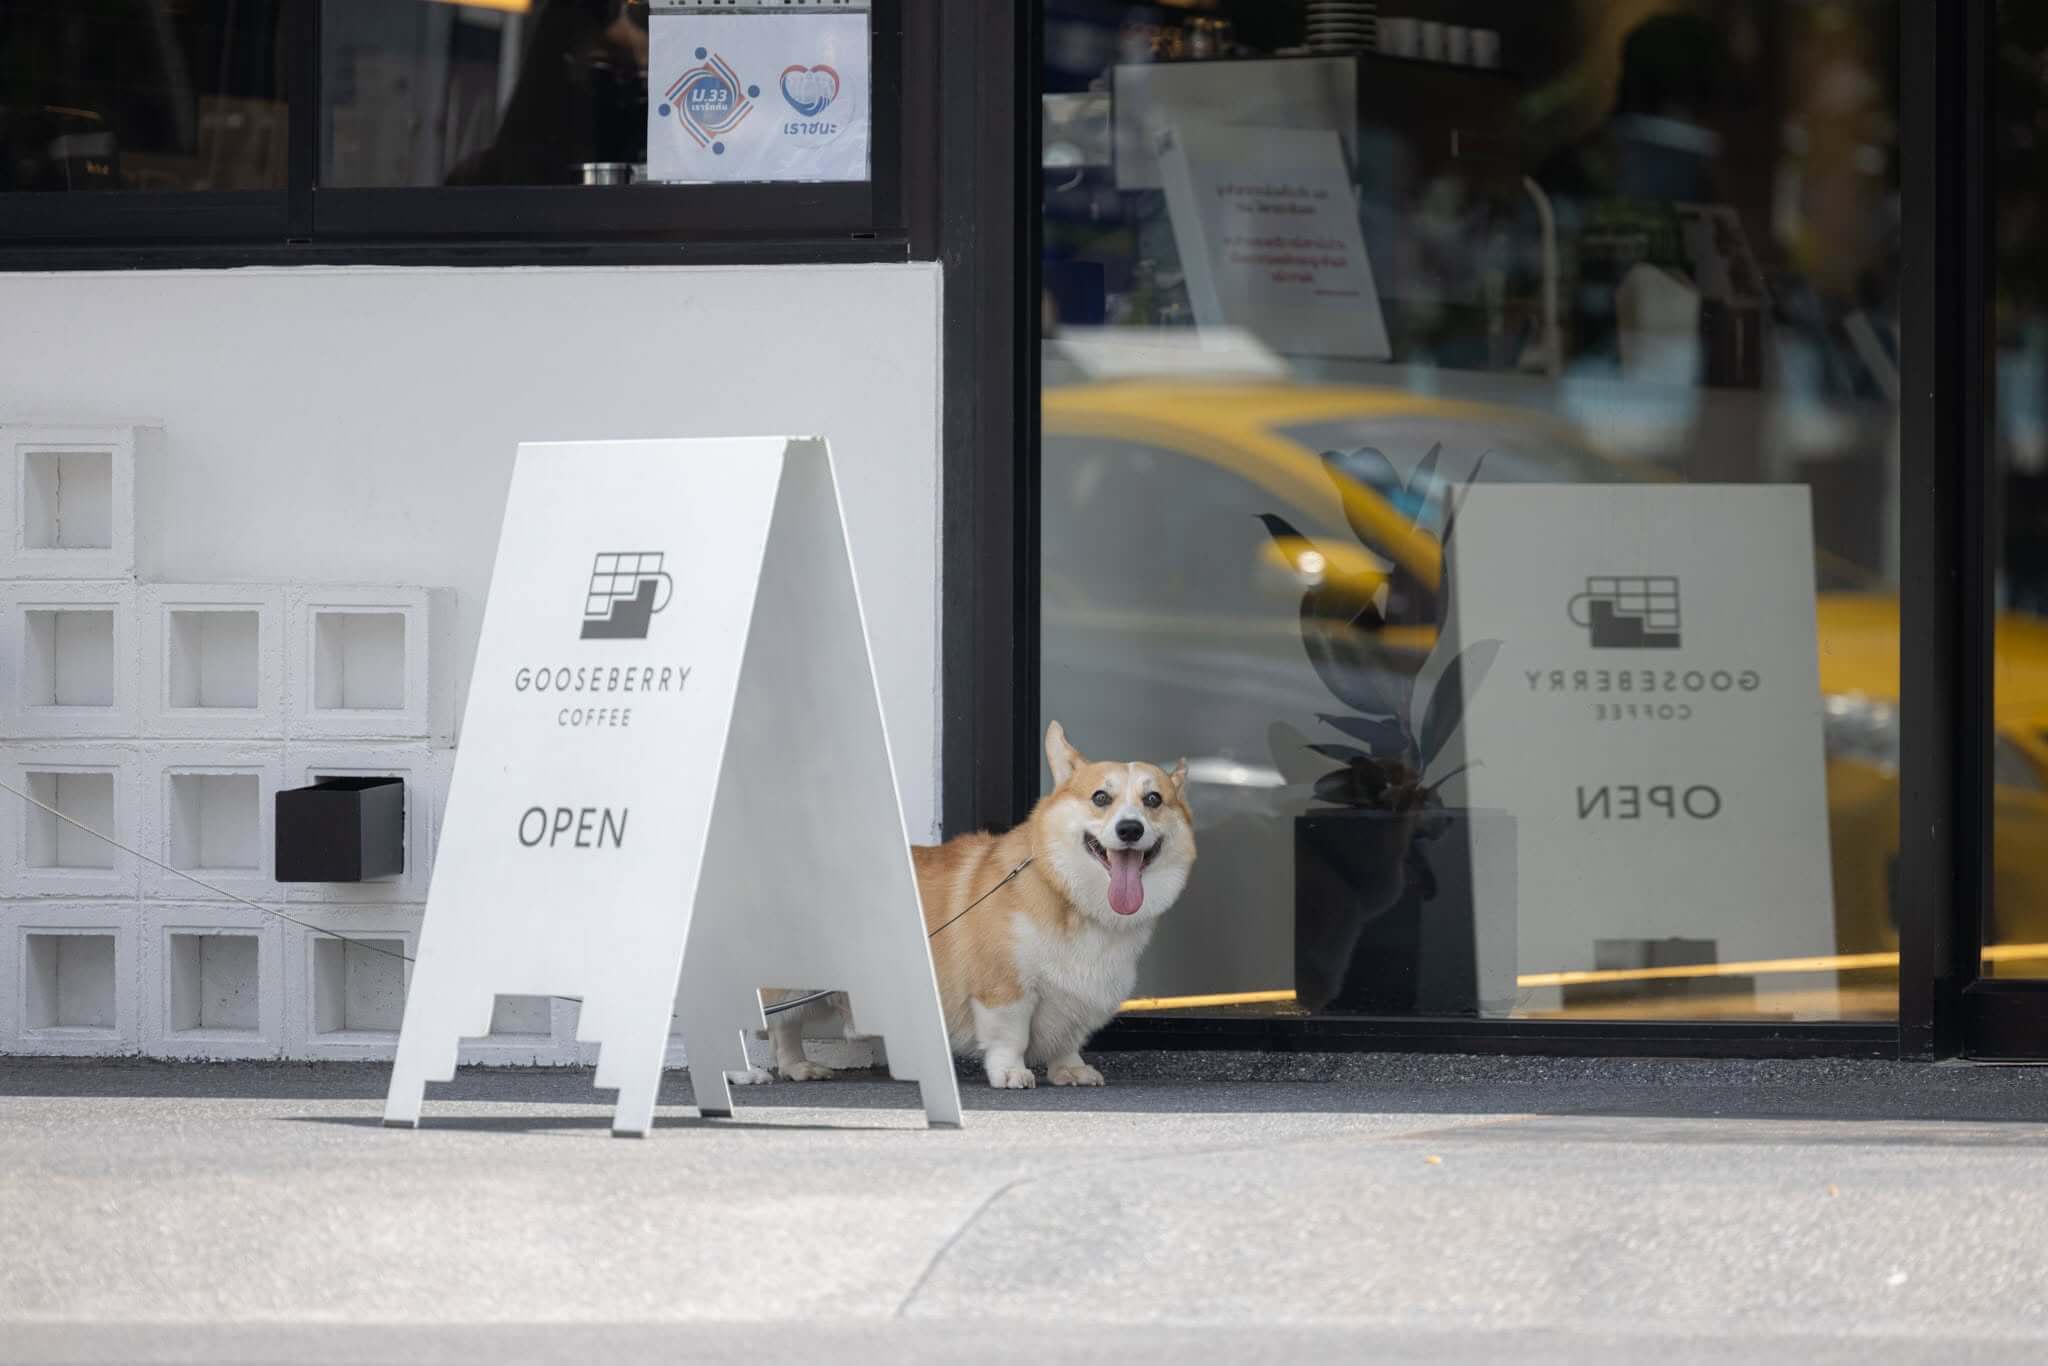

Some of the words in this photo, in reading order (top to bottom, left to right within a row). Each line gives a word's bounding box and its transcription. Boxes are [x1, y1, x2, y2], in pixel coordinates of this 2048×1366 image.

[783, 121, 838, 135] เราชนะ
[515, 667, 692, 692] GOOSEBERRY
[557, 708, 632, 727] COFFEE
[518, 806, 628, 848] OPEN
